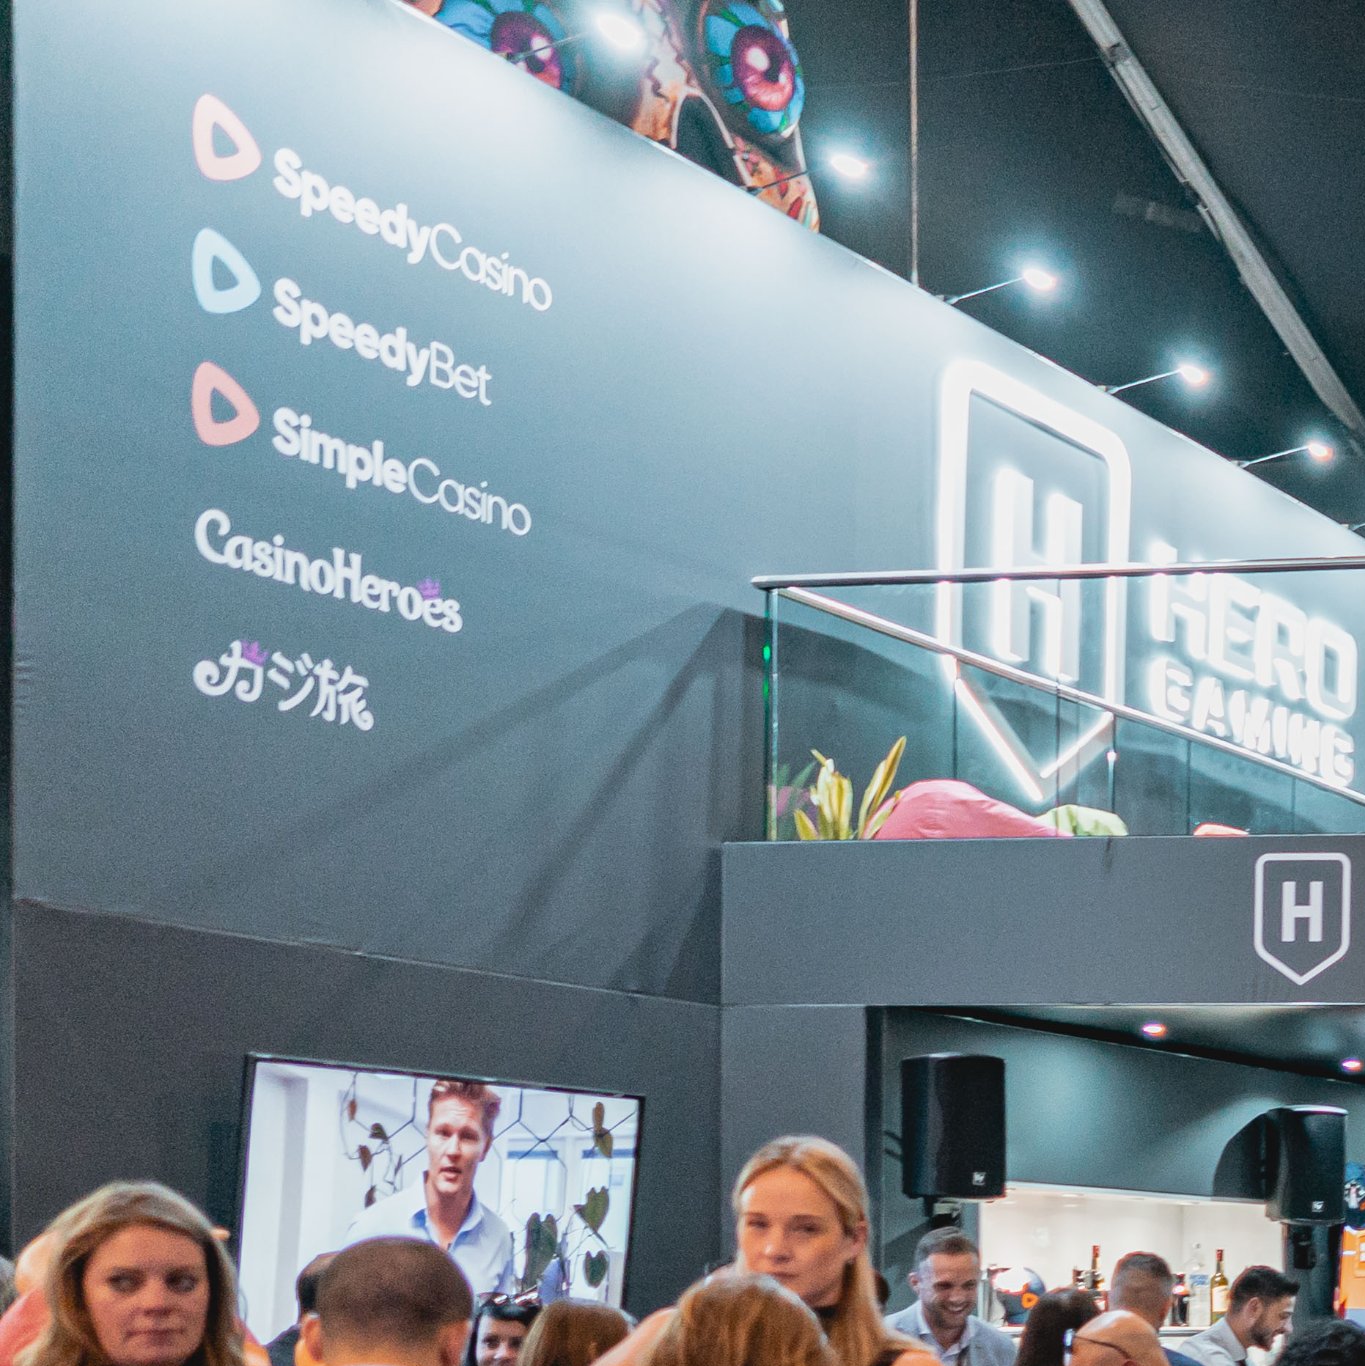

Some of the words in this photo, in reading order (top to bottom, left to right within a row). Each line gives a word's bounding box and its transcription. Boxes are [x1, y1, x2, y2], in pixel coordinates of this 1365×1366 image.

[273, 147, 552, 312] SpeedyCasino
[273, 277, 492, 406] SpeedyBet
[272, 406, 532, 536] SimpleCasino
[194, 508, 463, 633] CasinoHeroes
[1149, 540, 1357, 722] HERO
[193, 640, 375, 731] カジ旅
[1281, 881, 1323, 942] H
